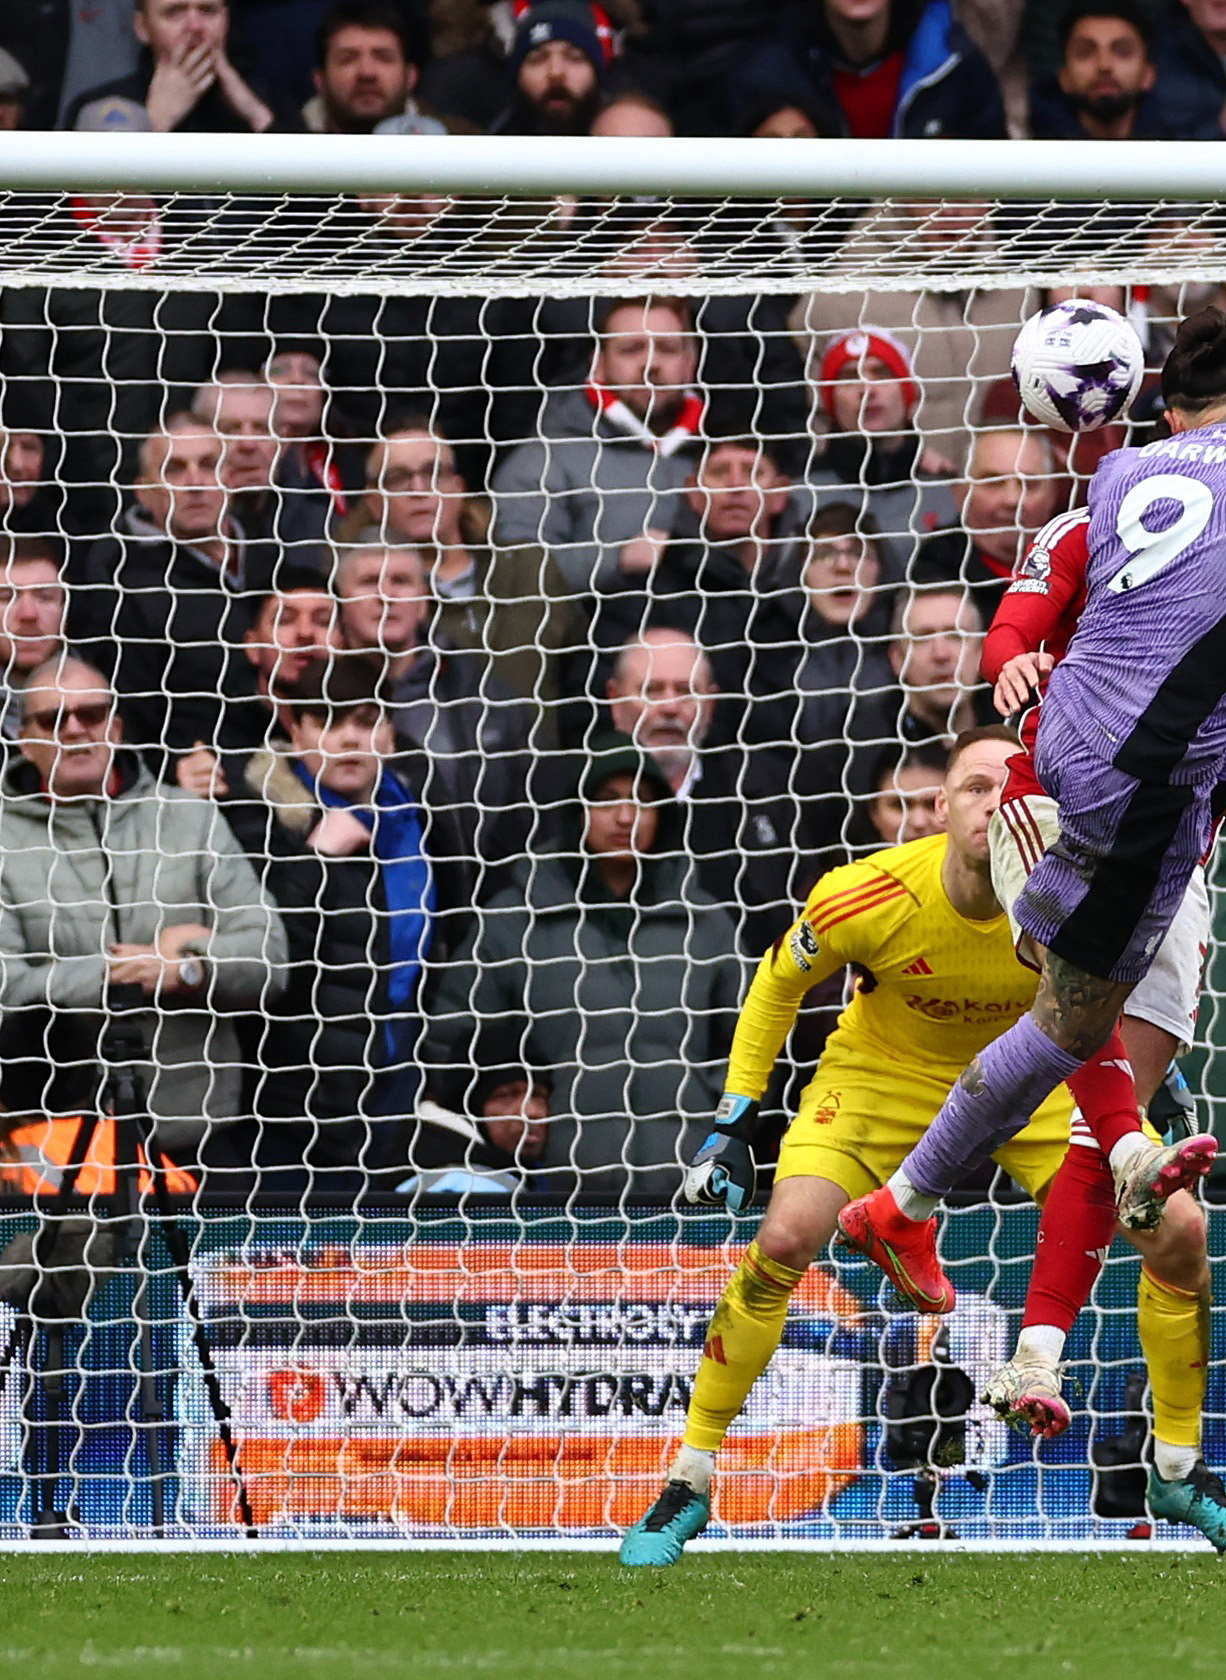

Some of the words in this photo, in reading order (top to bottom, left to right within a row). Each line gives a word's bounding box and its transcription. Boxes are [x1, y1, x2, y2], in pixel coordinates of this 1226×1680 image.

[1106, 473, 1215, 594] 9
[485, 1304, 715, 1340] ELECTROLY
[331, 1370, 698, 1418] WOWHYDRA
